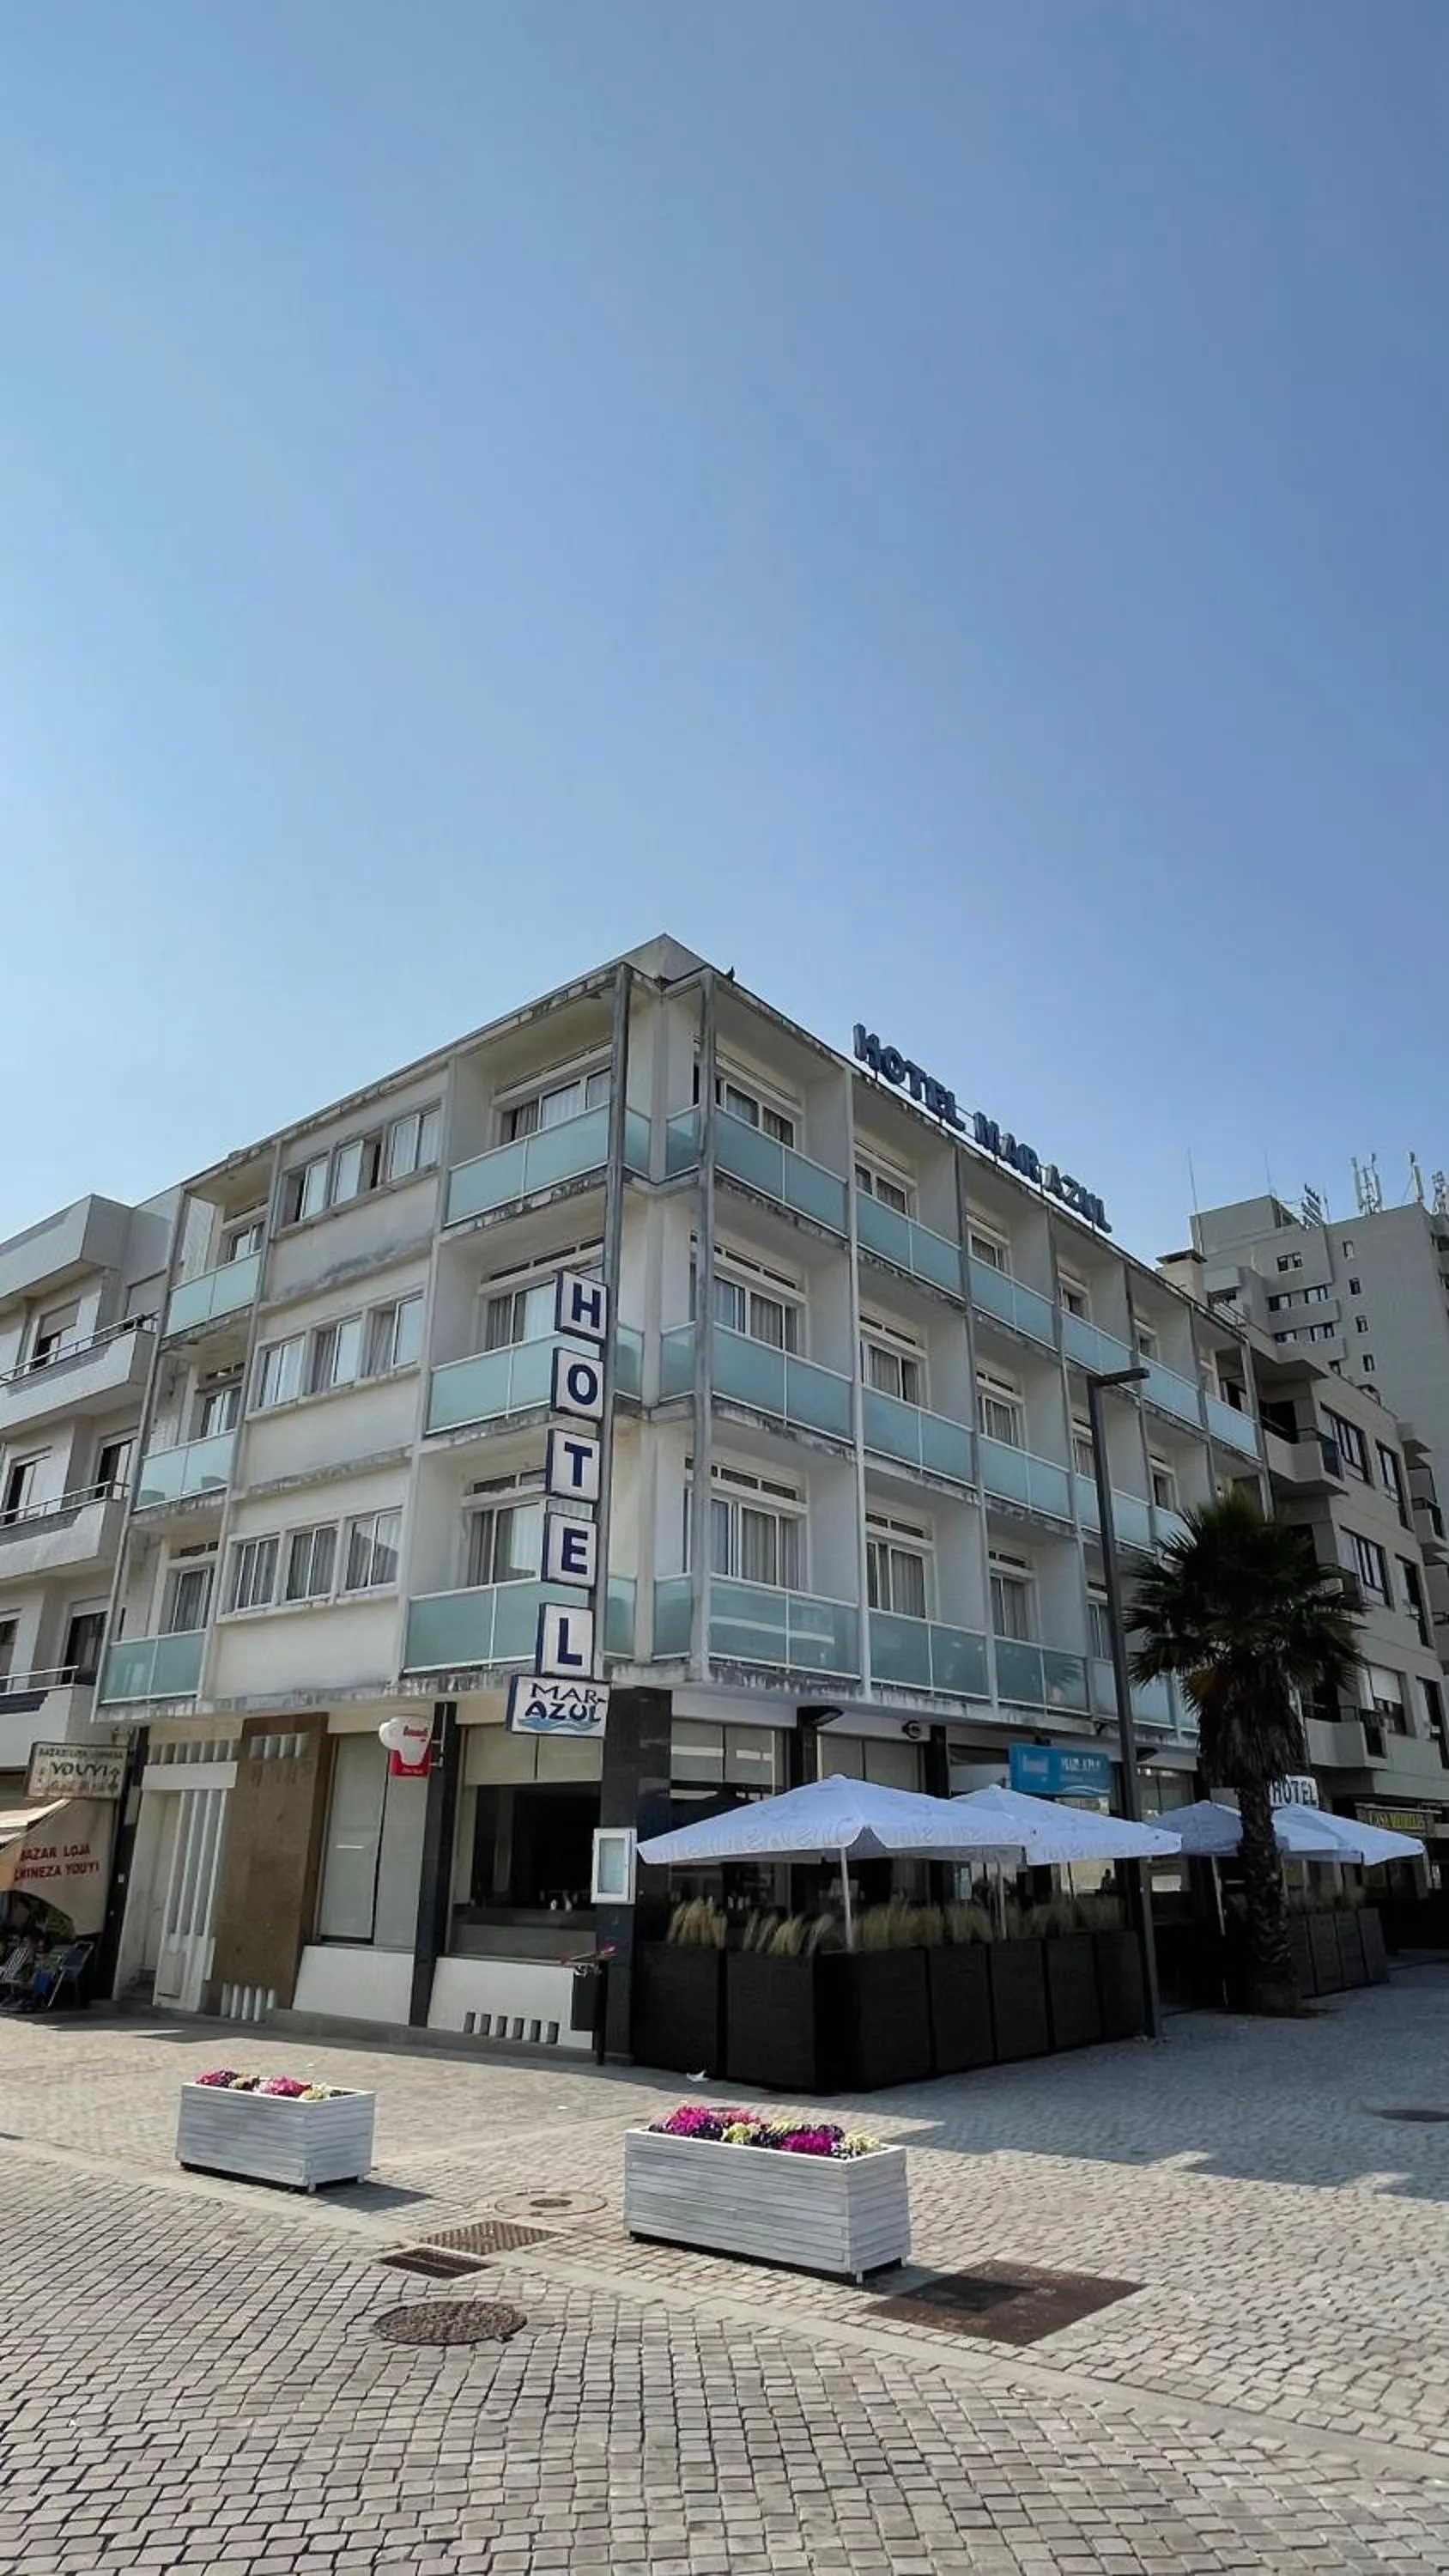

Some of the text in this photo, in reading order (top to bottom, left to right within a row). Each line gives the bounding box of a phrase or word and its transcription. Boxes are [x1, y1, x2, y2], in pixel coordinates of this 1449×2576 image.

[853, 1023, 1113, 1234] HOTEL MAR AZUL
[556, 1282, 601, 1666] HOTEL
[524, 1700, 602, 1722] AZUL
[51, 1762, 108, 1777] YOUYI
[1271, 1779, 1317, 1805] HOTEL
[64, 1844, 90, 1857] LOJA
[65, 1861, 100, 1875] YOUYI
